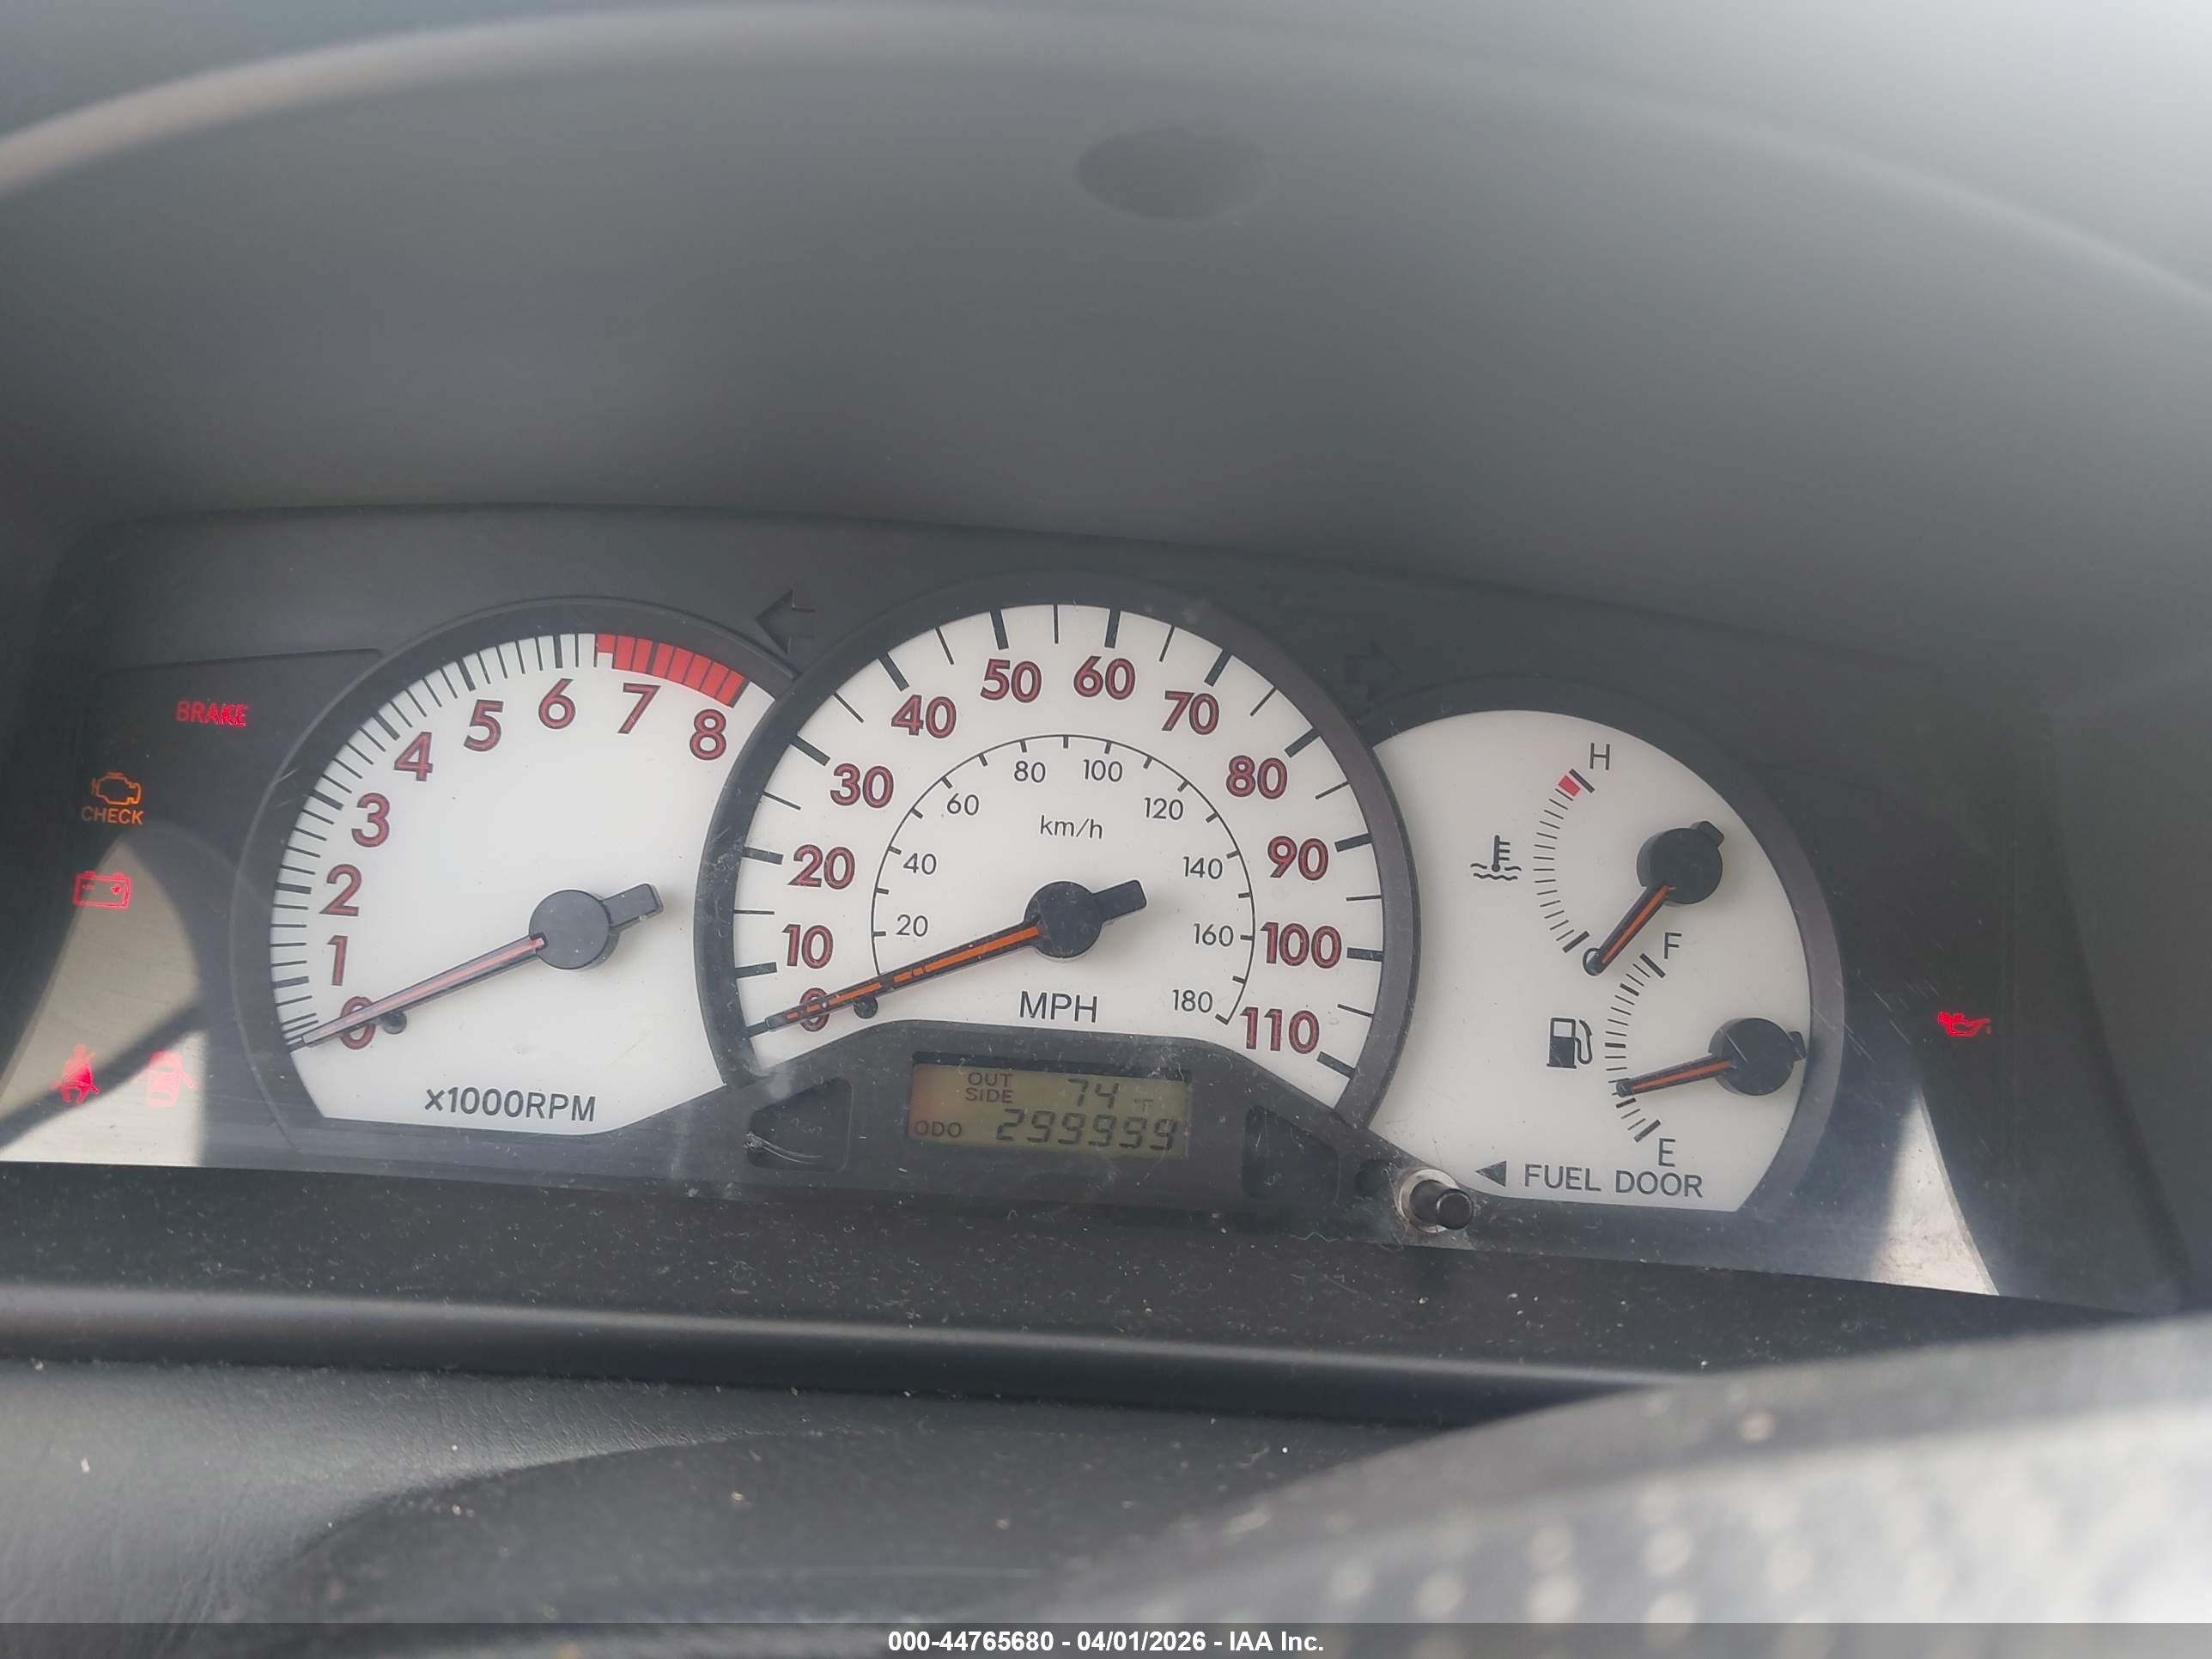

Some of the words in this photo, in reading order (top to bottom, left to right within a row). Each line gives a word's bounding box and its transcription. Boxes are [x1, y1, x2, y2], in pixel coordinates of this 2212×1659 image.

[981, 659, 1042, 702] 50
[1073, 656, 1136, 700] 60
[175, 699, 247, 728] BRAKE
[538, 678, 576, 729] 6
[617, 683, 659, 734] 7
[891, 695, 957, 738] 40
[1161, 691, 1220, 735] 70
[464, 699, 503, 751] 5
[690, 709, 726, 760] 8
[393, 732, 433, 781] 4
[1013, 760, 1047, 784] 80
[1082, 758, 1123, 783] 100
[1589, 743, 1611, 770] H
[830, 764, 894, 808] 30
[1226, 755, 1288, 799] 80
[81, 805, 143, 825] CHECK
[351, 793, 390, 848] 3
[946, 793, 981, 817] 60
[1143, 796, 1184, 821] 120
[1039, 815, 1103, 841] km/h
[788, 844, 855, 889] 20
[903, 853, 938, 877] 40
[1182, 856, 1224, 880] 140
[1267, 836, 1329, 880] 90
[319, 864, 362, 917] 2
[896, 915, 928, 939] 20
[1193, 924, 1234, 947] 160
[326, 935, 349, 986] 1
[781, 923, 834, 969] 10
[1261, 922, 1341, 969] 100
[1663, 932, 1682, 959] F
[1018, 990, 1098, 1023] MPH
[1171, 989, 1213, 1013] 180
[1239, 1006, 1320, 1054] 110
[964, 1087, 1012, 1103] SIDE
[967, 1073, 1012, 1088] OUT
[1066, 1079, 1120, 1109] 74
[914, 1121, 963, 1139] ODO
[996, 1109, 1178, 1152] 299999
[1658, 1138, 1677, 1167] E
[1523, 1164, 1601, 1192] FUEL
[1615, 1170, 1703, 1198] DOOR
